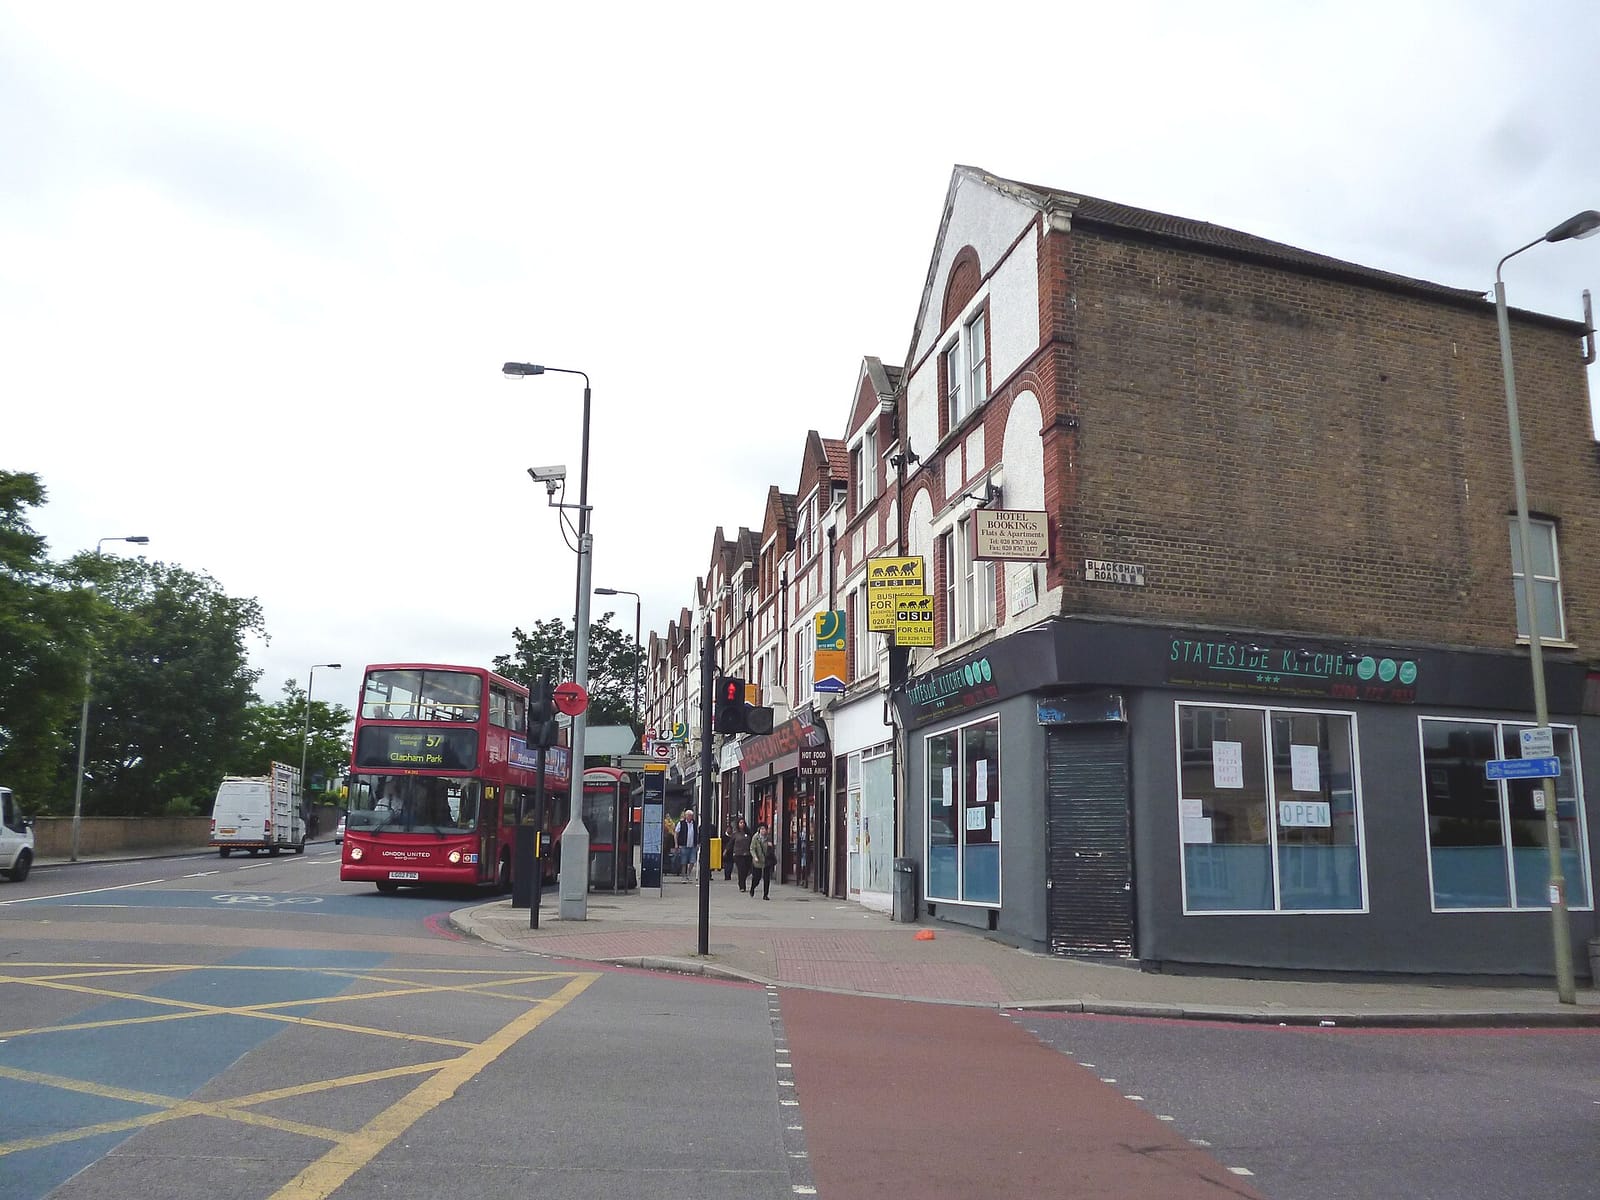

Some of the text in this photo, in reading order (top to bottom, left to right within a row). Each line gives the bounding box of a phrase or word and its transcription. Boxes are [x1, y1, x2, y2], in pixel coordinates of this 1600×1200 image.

[996, 512, 1028, 521] HOTEL
[987, 520, 1038, 530] BOOKINGS
[1007, 530, 1045, 538] Apartments
[1088, 561, 1143, 575] BLACKSHAW
[1094, 571, 1119, 582] ROAD
[870, 601, 892, 610] FOR
[426, 735, 442, 747] 57
[390, 752, 443, 763] Clapham Park
[1283, 804, 1326, 824] OPEN
